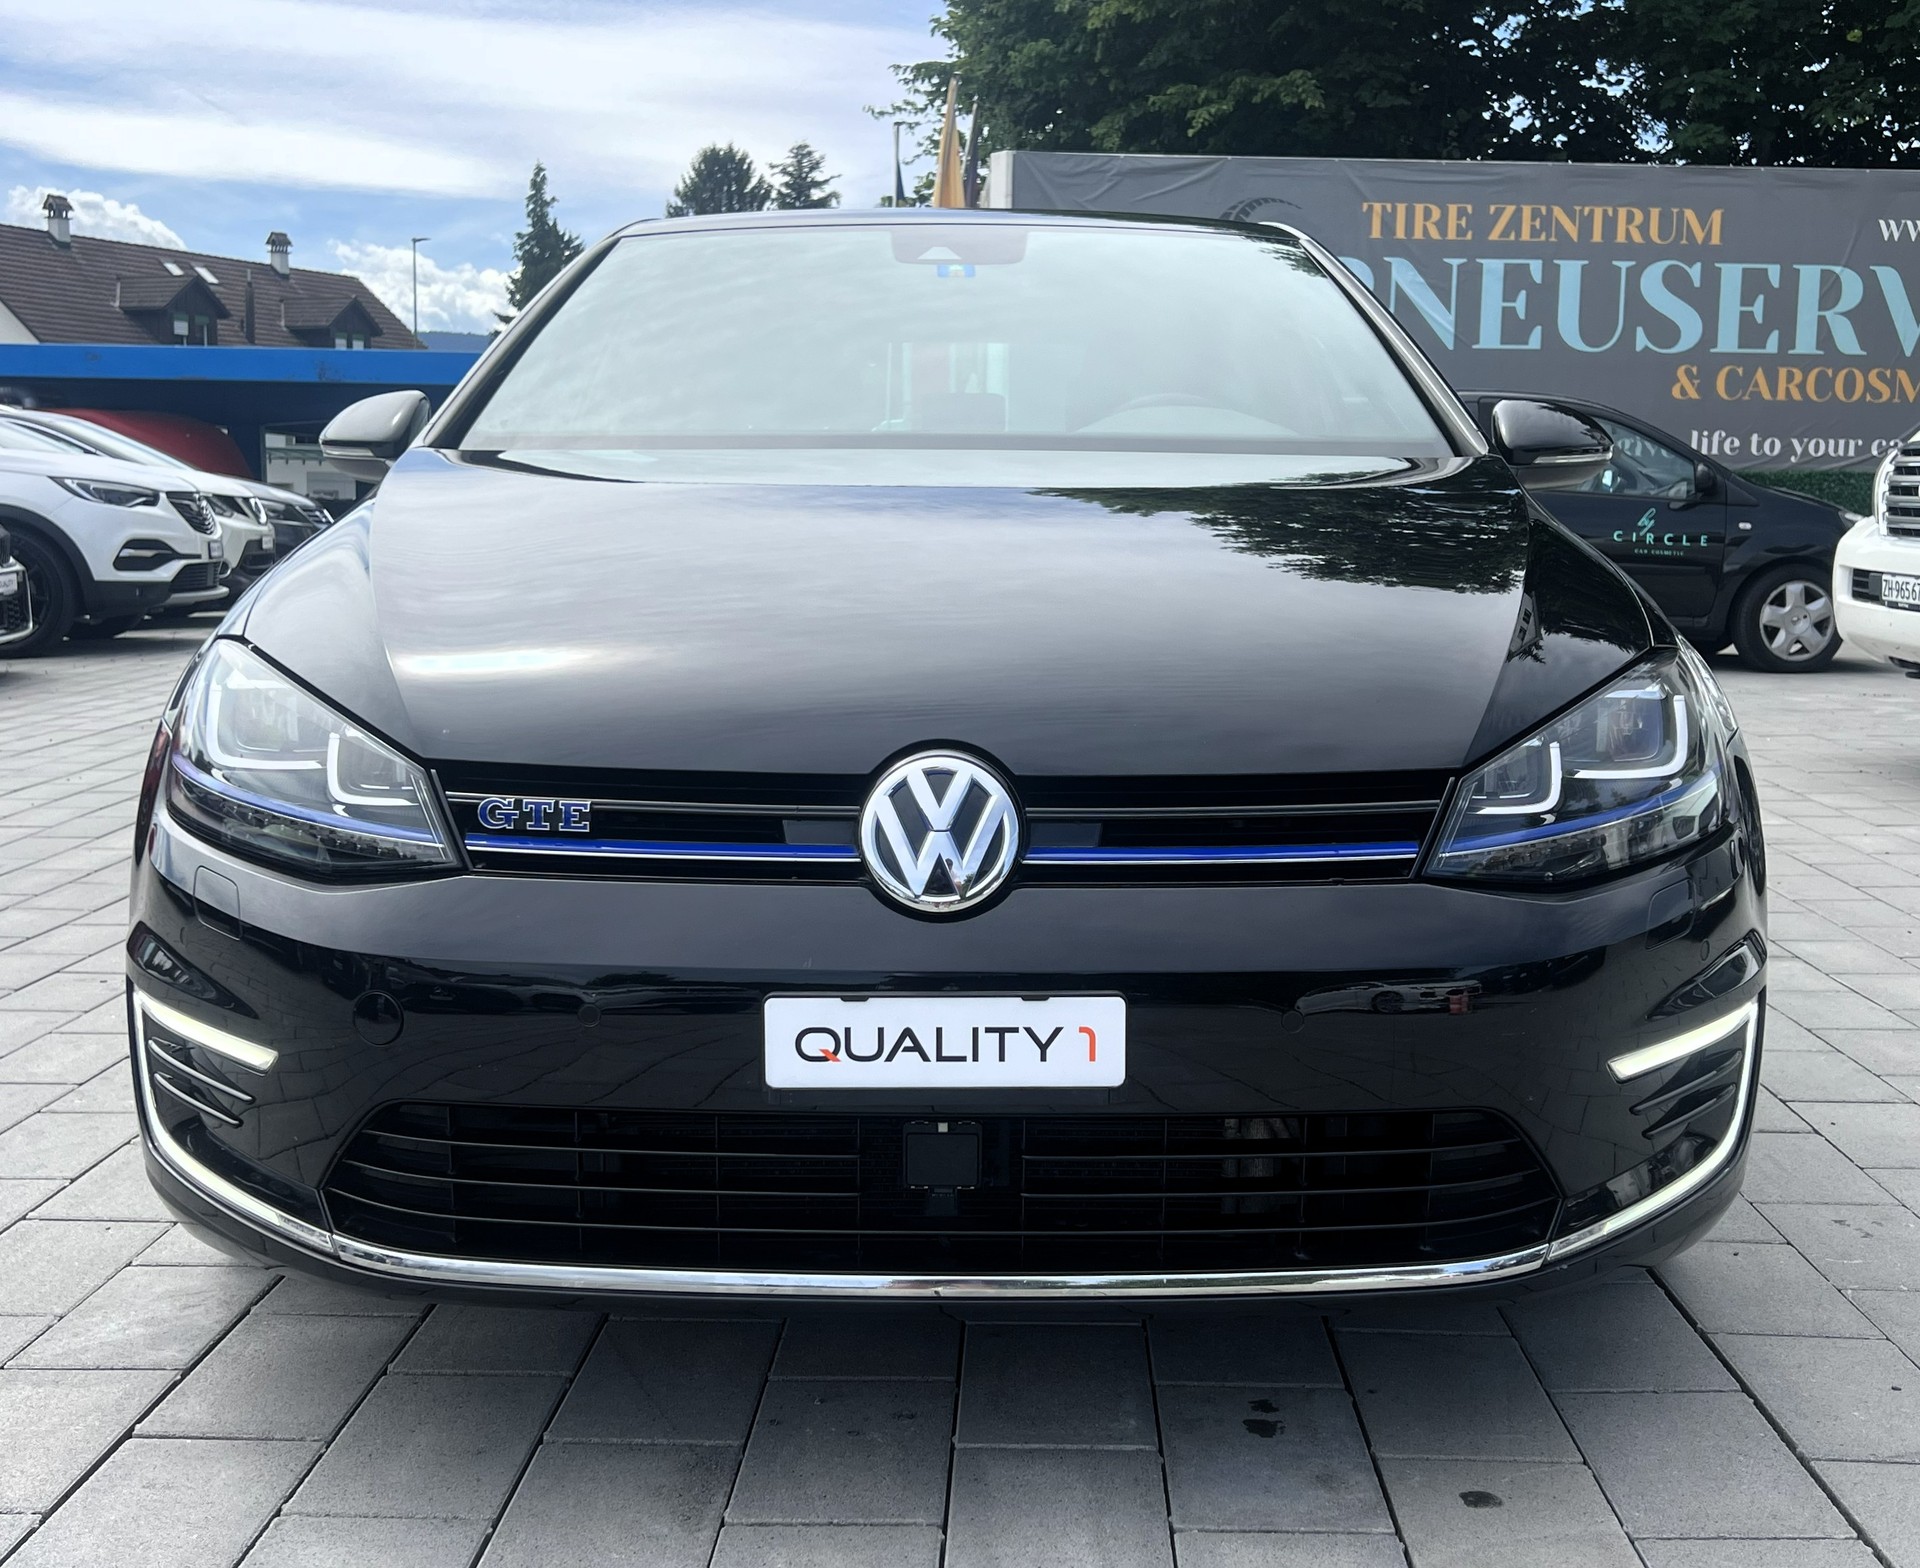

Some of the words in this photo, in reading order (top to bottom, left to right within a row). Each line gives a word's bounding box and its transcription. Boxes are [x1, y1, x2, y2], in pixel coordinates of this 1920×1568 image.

[1362, 202, 1473, 240] TIRE
[1488, 204, 1724, 246] ZENTRUM
[1672, 364, 1700, 400] &
[1691, 429, 1740, 456] life
[1750, 433, 1781, 456] to
[1790, 437, 1863, 463] your
[1613, 530, 1708, 547] CIRCLE
[477, 797, 592, 832] GTE
[795, 1026, 1064, 1063] QUALITY
[1078, 1026, 1097, 1063] 1
